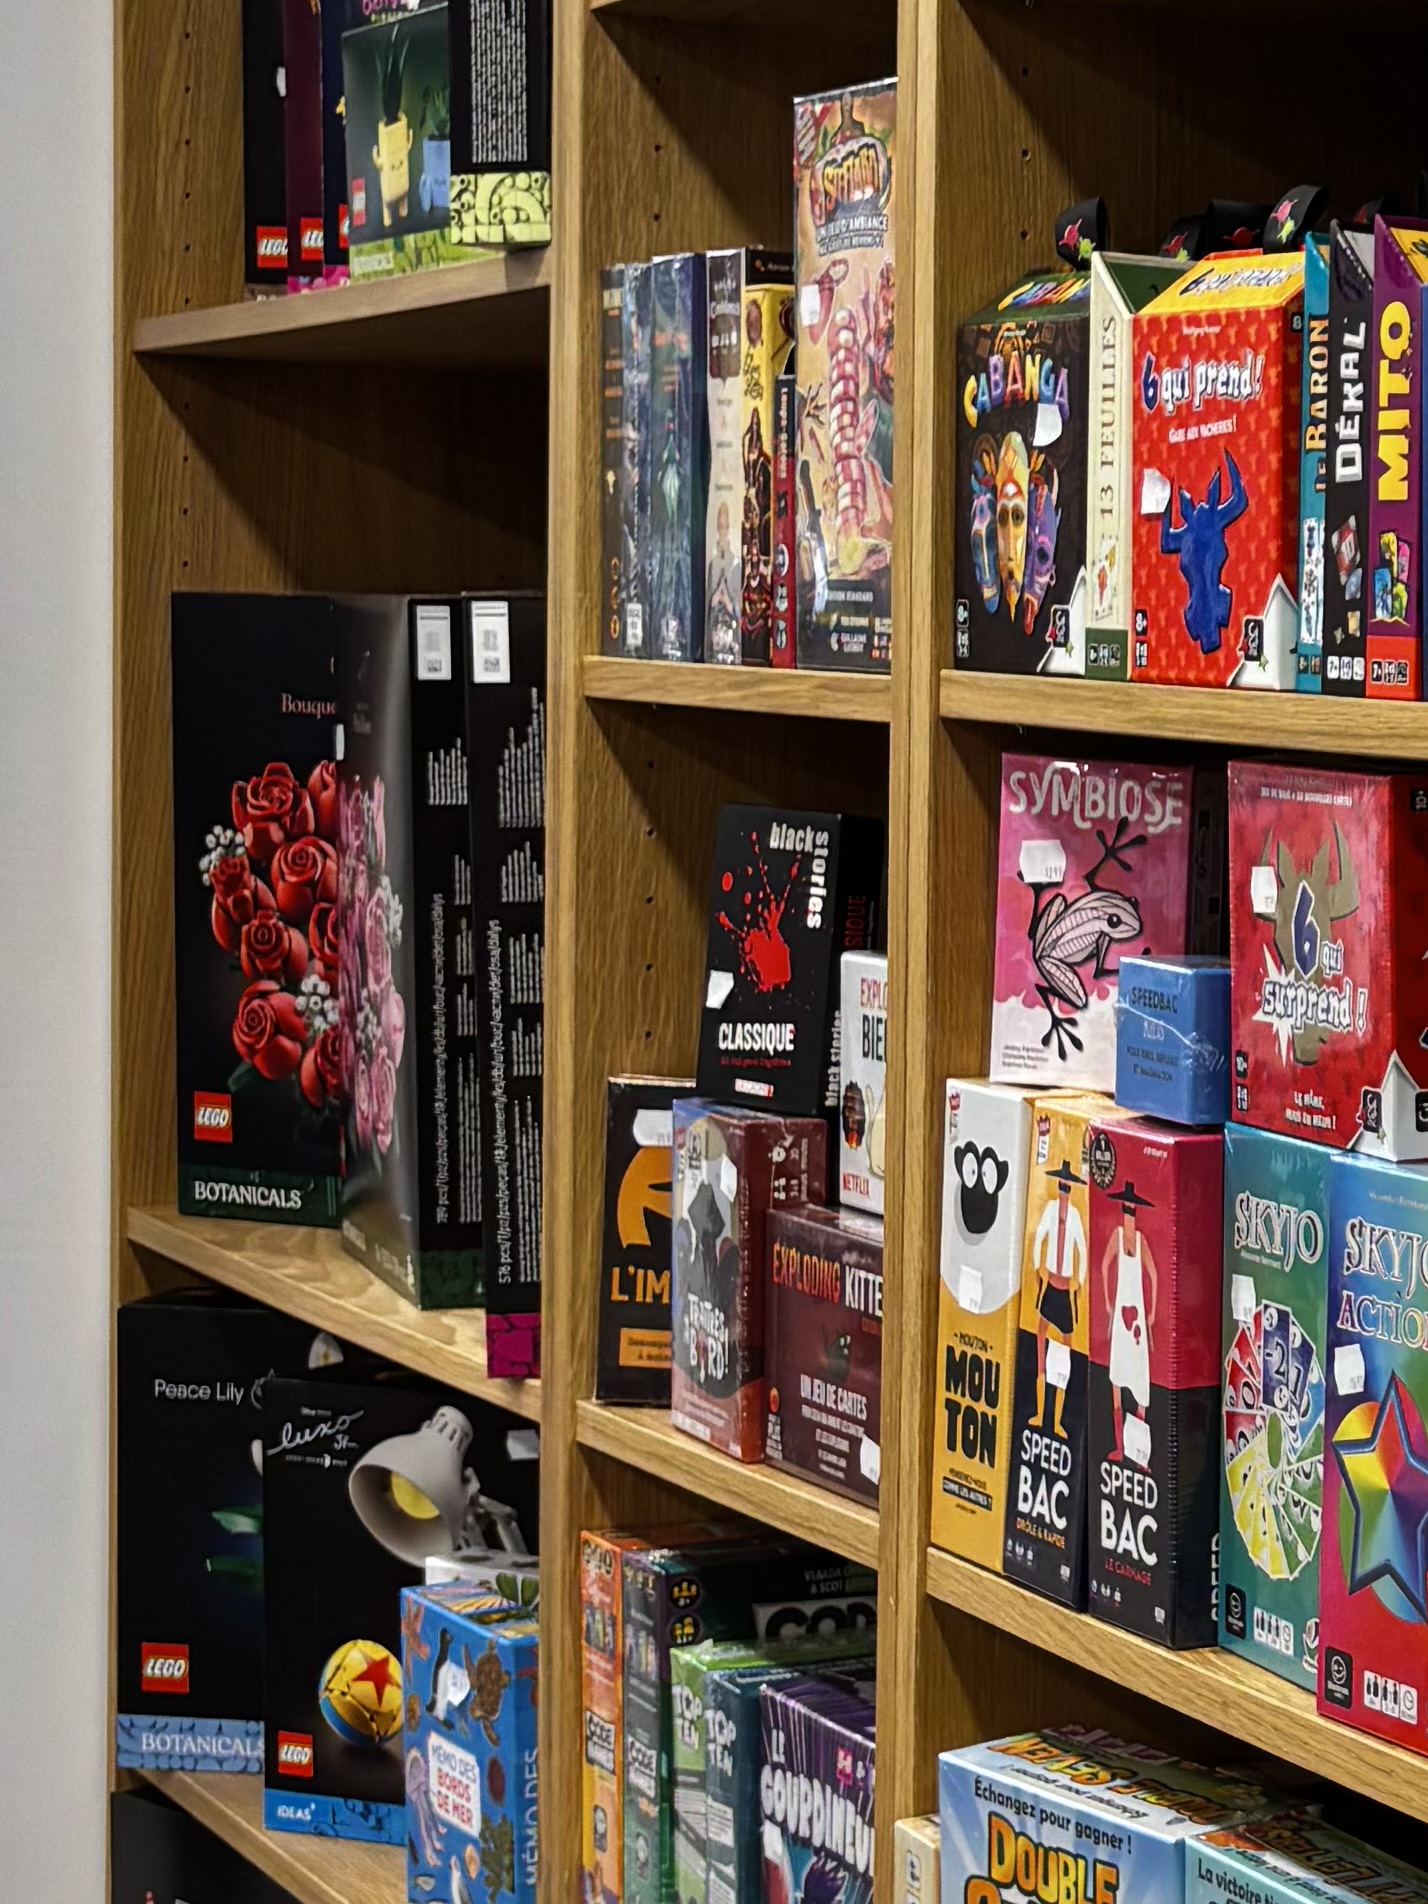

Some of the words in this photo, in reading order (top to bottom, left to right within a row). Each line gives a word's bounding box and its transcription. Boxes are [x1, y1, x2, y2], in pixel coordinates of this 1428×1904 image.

[1376, 301, 1413, 502] MITO
[769, 821, 811, 852] black
[805, 830, 830, 929] stories
[718, 1021, 796, 1052] CLASSIQUE
[197, 1104, 230, 1132] LEGO
[194, 1181, 302, 1210] BOTANICALS
[842, 1171, 871, 1194] NETFLIX
[1234, 1191, 1323, 1269] SKYJO
[772, 1243, 841, 1304] EXPLODING
[154, 1379, 211, 1400] Peace
[217, 1379, 245, 1405] Lily
[1019, 1428, 1072, 1475] SPEED
[1016, 1474, 1070, 1532] BAC
[144, 1658, 186, 1678] LEGO
[280, 1742, 312, 1765] LEGO
[974, 1777, 1036, 1818] Échangez
[1039, 1806, 1072, 1833] pour
[1074, 1820, 1124, 1852] gagner
